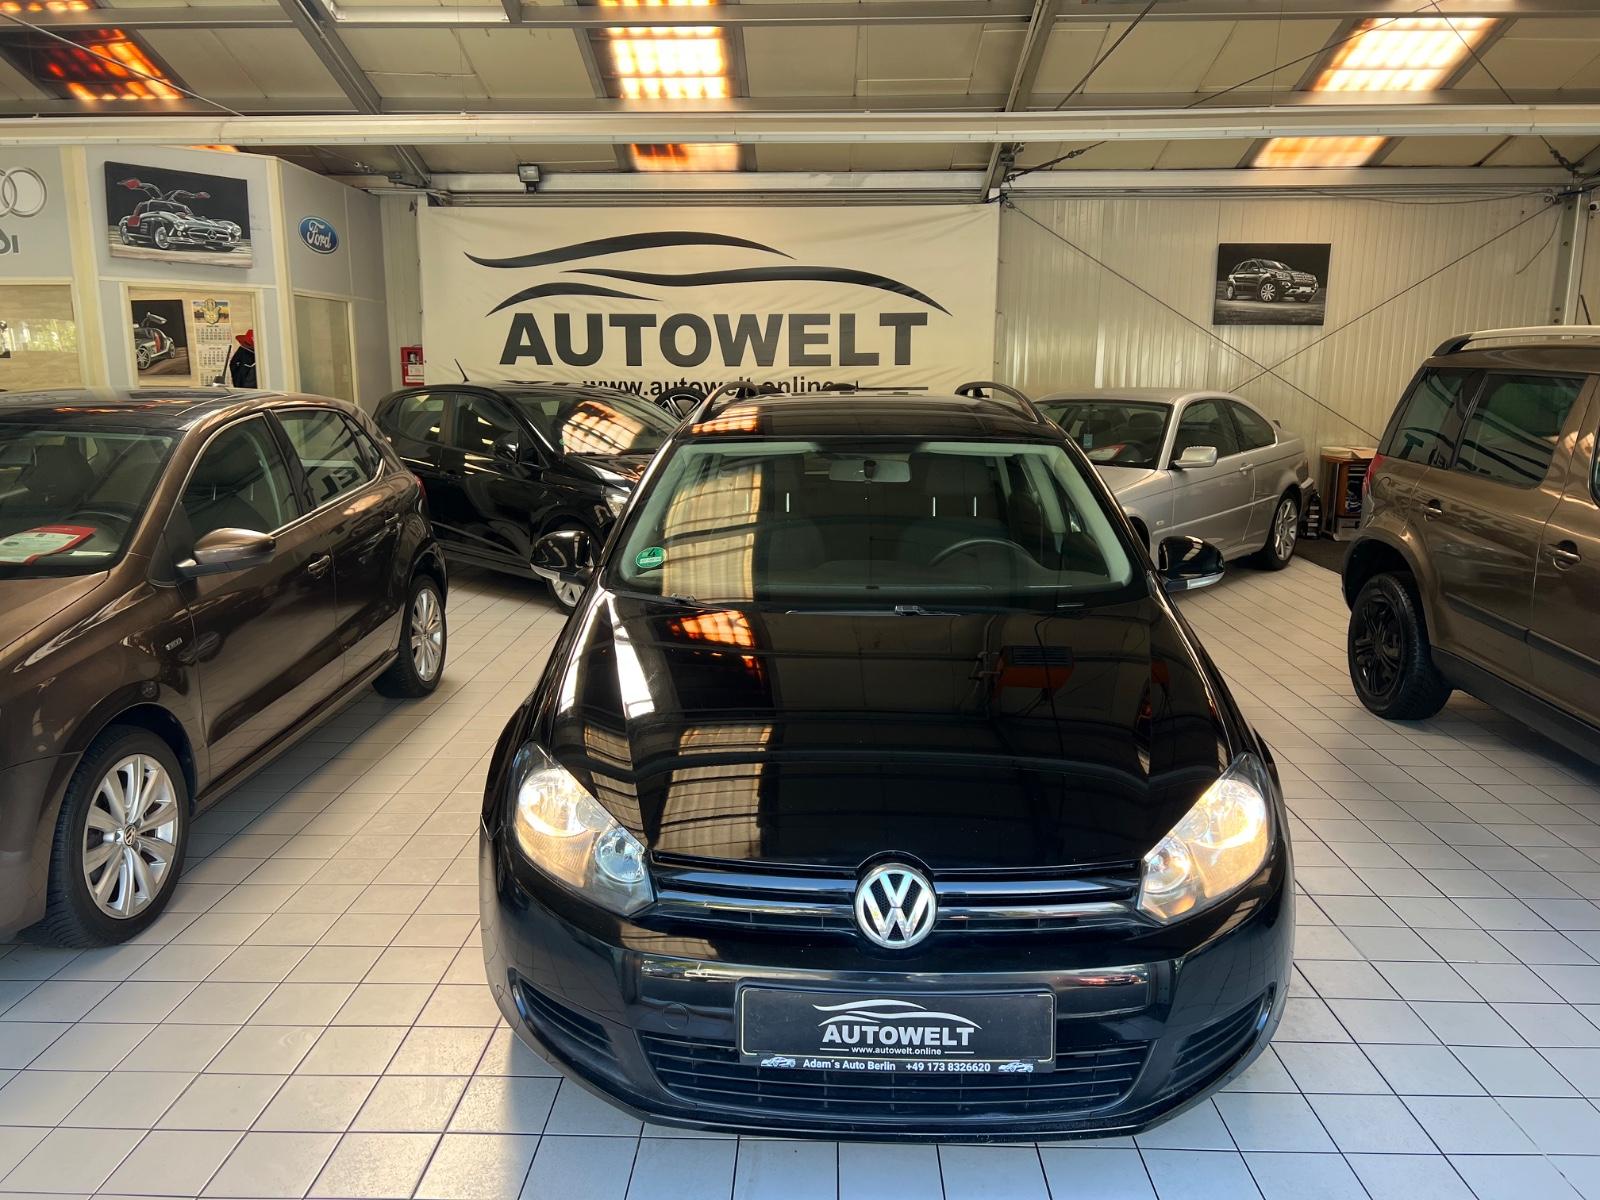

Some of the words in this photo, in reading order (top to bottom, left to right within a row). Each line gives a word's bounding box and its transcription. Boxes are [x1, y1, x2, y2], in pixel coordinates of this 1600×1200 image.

[306, 220, 332, 249] Ford
[499, 312, 928, 368] AUTOWELT
[822, 1024, 975, 1047] AUTOWELT
[851, 1046, 942, 1056] www.autowelt.online
[842, 1060, 866, 1071] Auto
[867, 1060, 897, 1072] Berlin
[905, 1062, 925, 1072] +49
[927, 1062, 946, 1072] 173
[947, 1062, 991, 1073] 8326620
